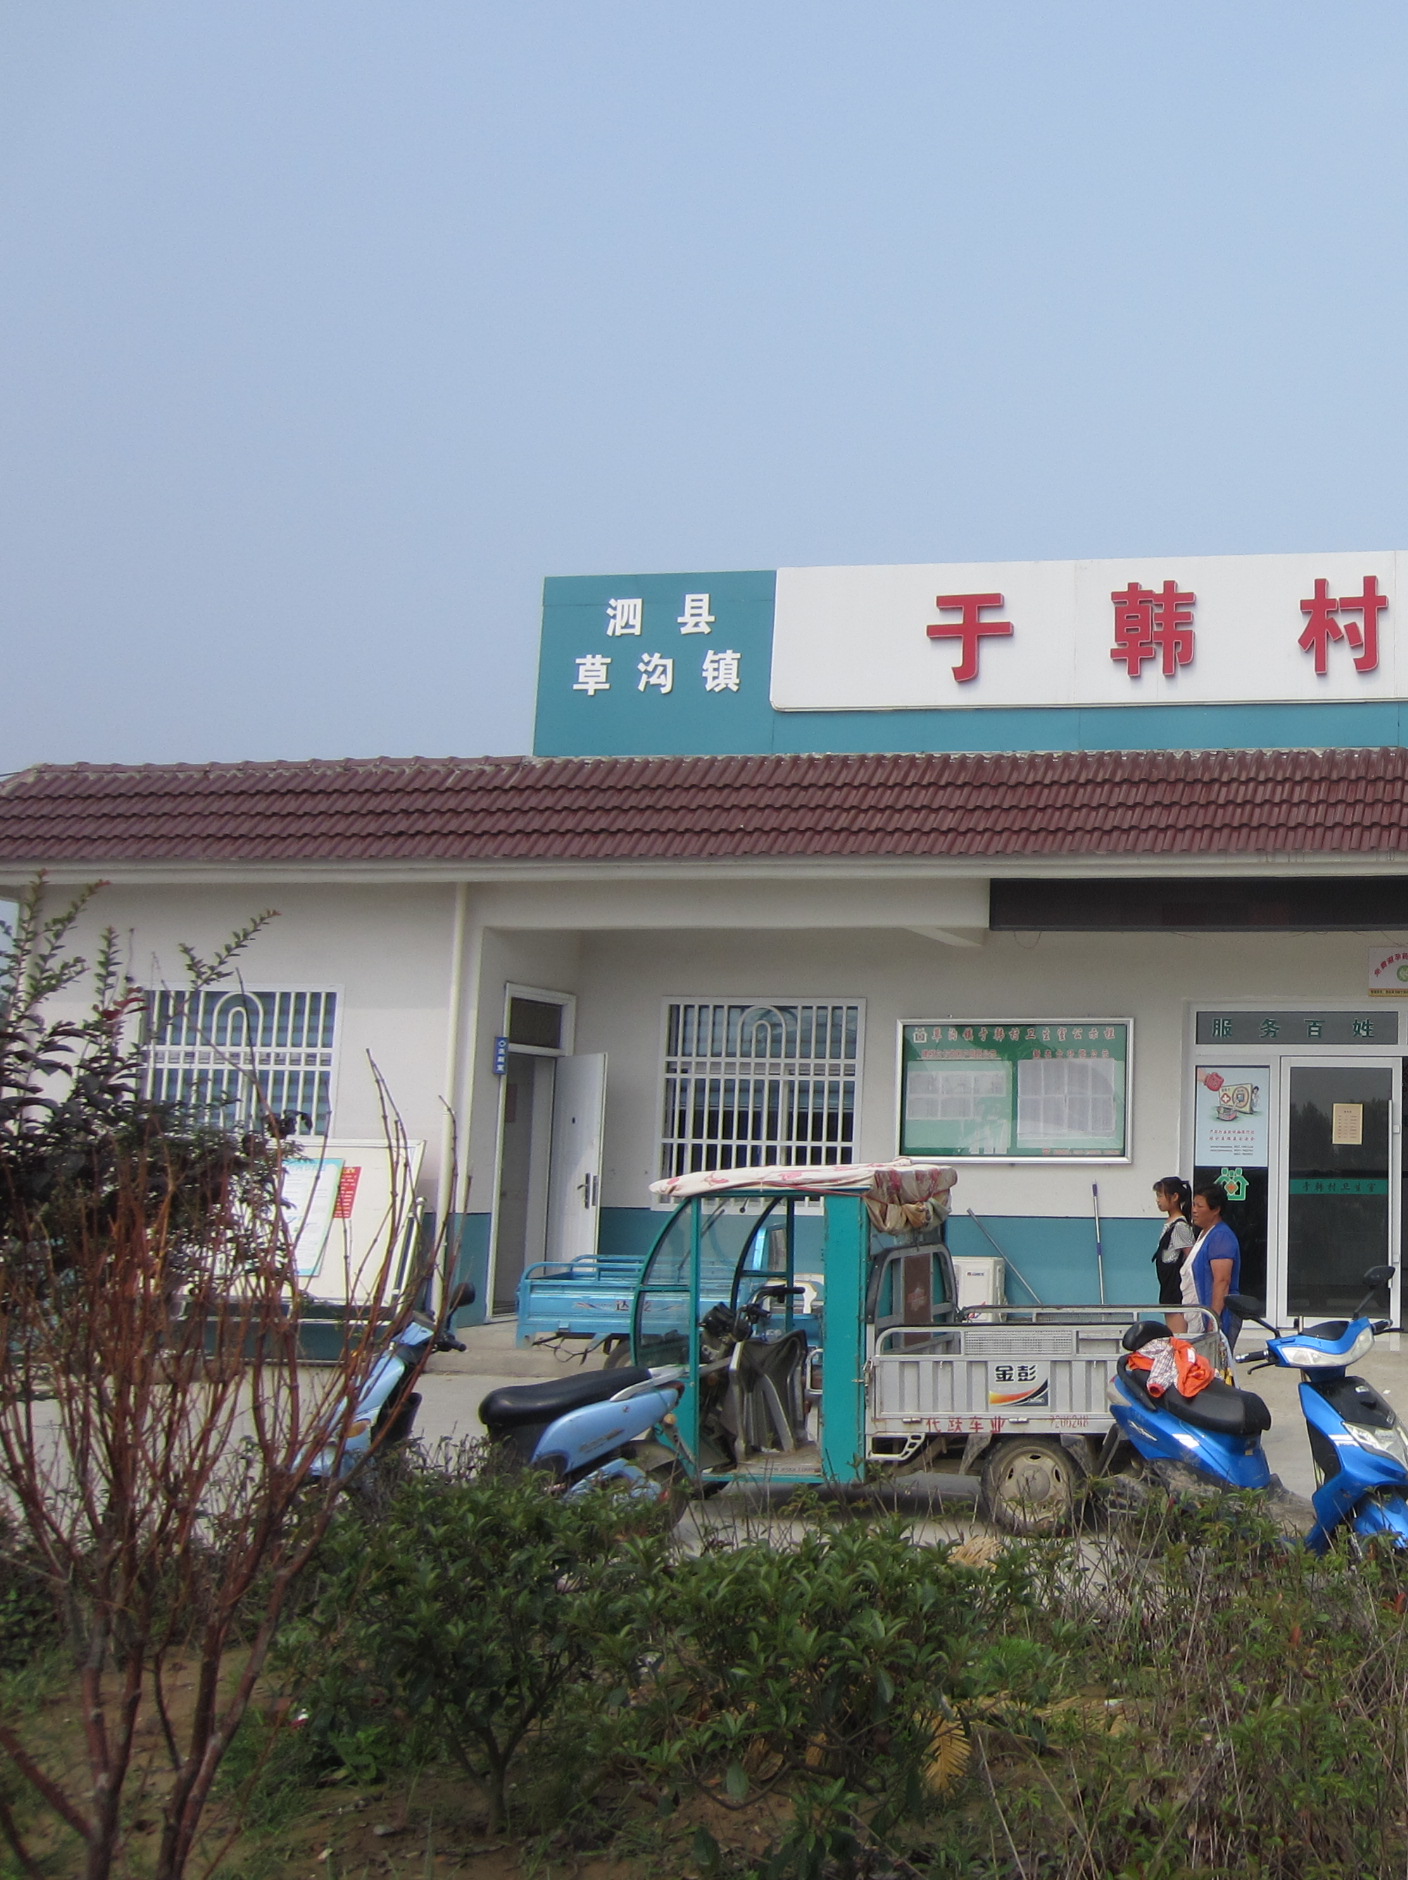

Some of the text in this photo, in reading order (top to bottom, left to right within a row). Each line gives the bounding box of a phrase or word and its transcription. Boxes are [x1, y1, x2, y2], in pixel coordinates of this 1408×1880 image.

[607, 594, 716, 637] 泗县
[926, 575, 1389, 684] 于韩村
[573, 649, 742, 696] 草沟镇
[930, 1026, 1116, 1042] 草沟镇于韩村卫生室公示栏
[1211, 1017, 1375, 1038] 服务百姓
[995, 1365, 1036, 1382] 金彭
[926, 1416, 1005, 1434] 代跃车业
